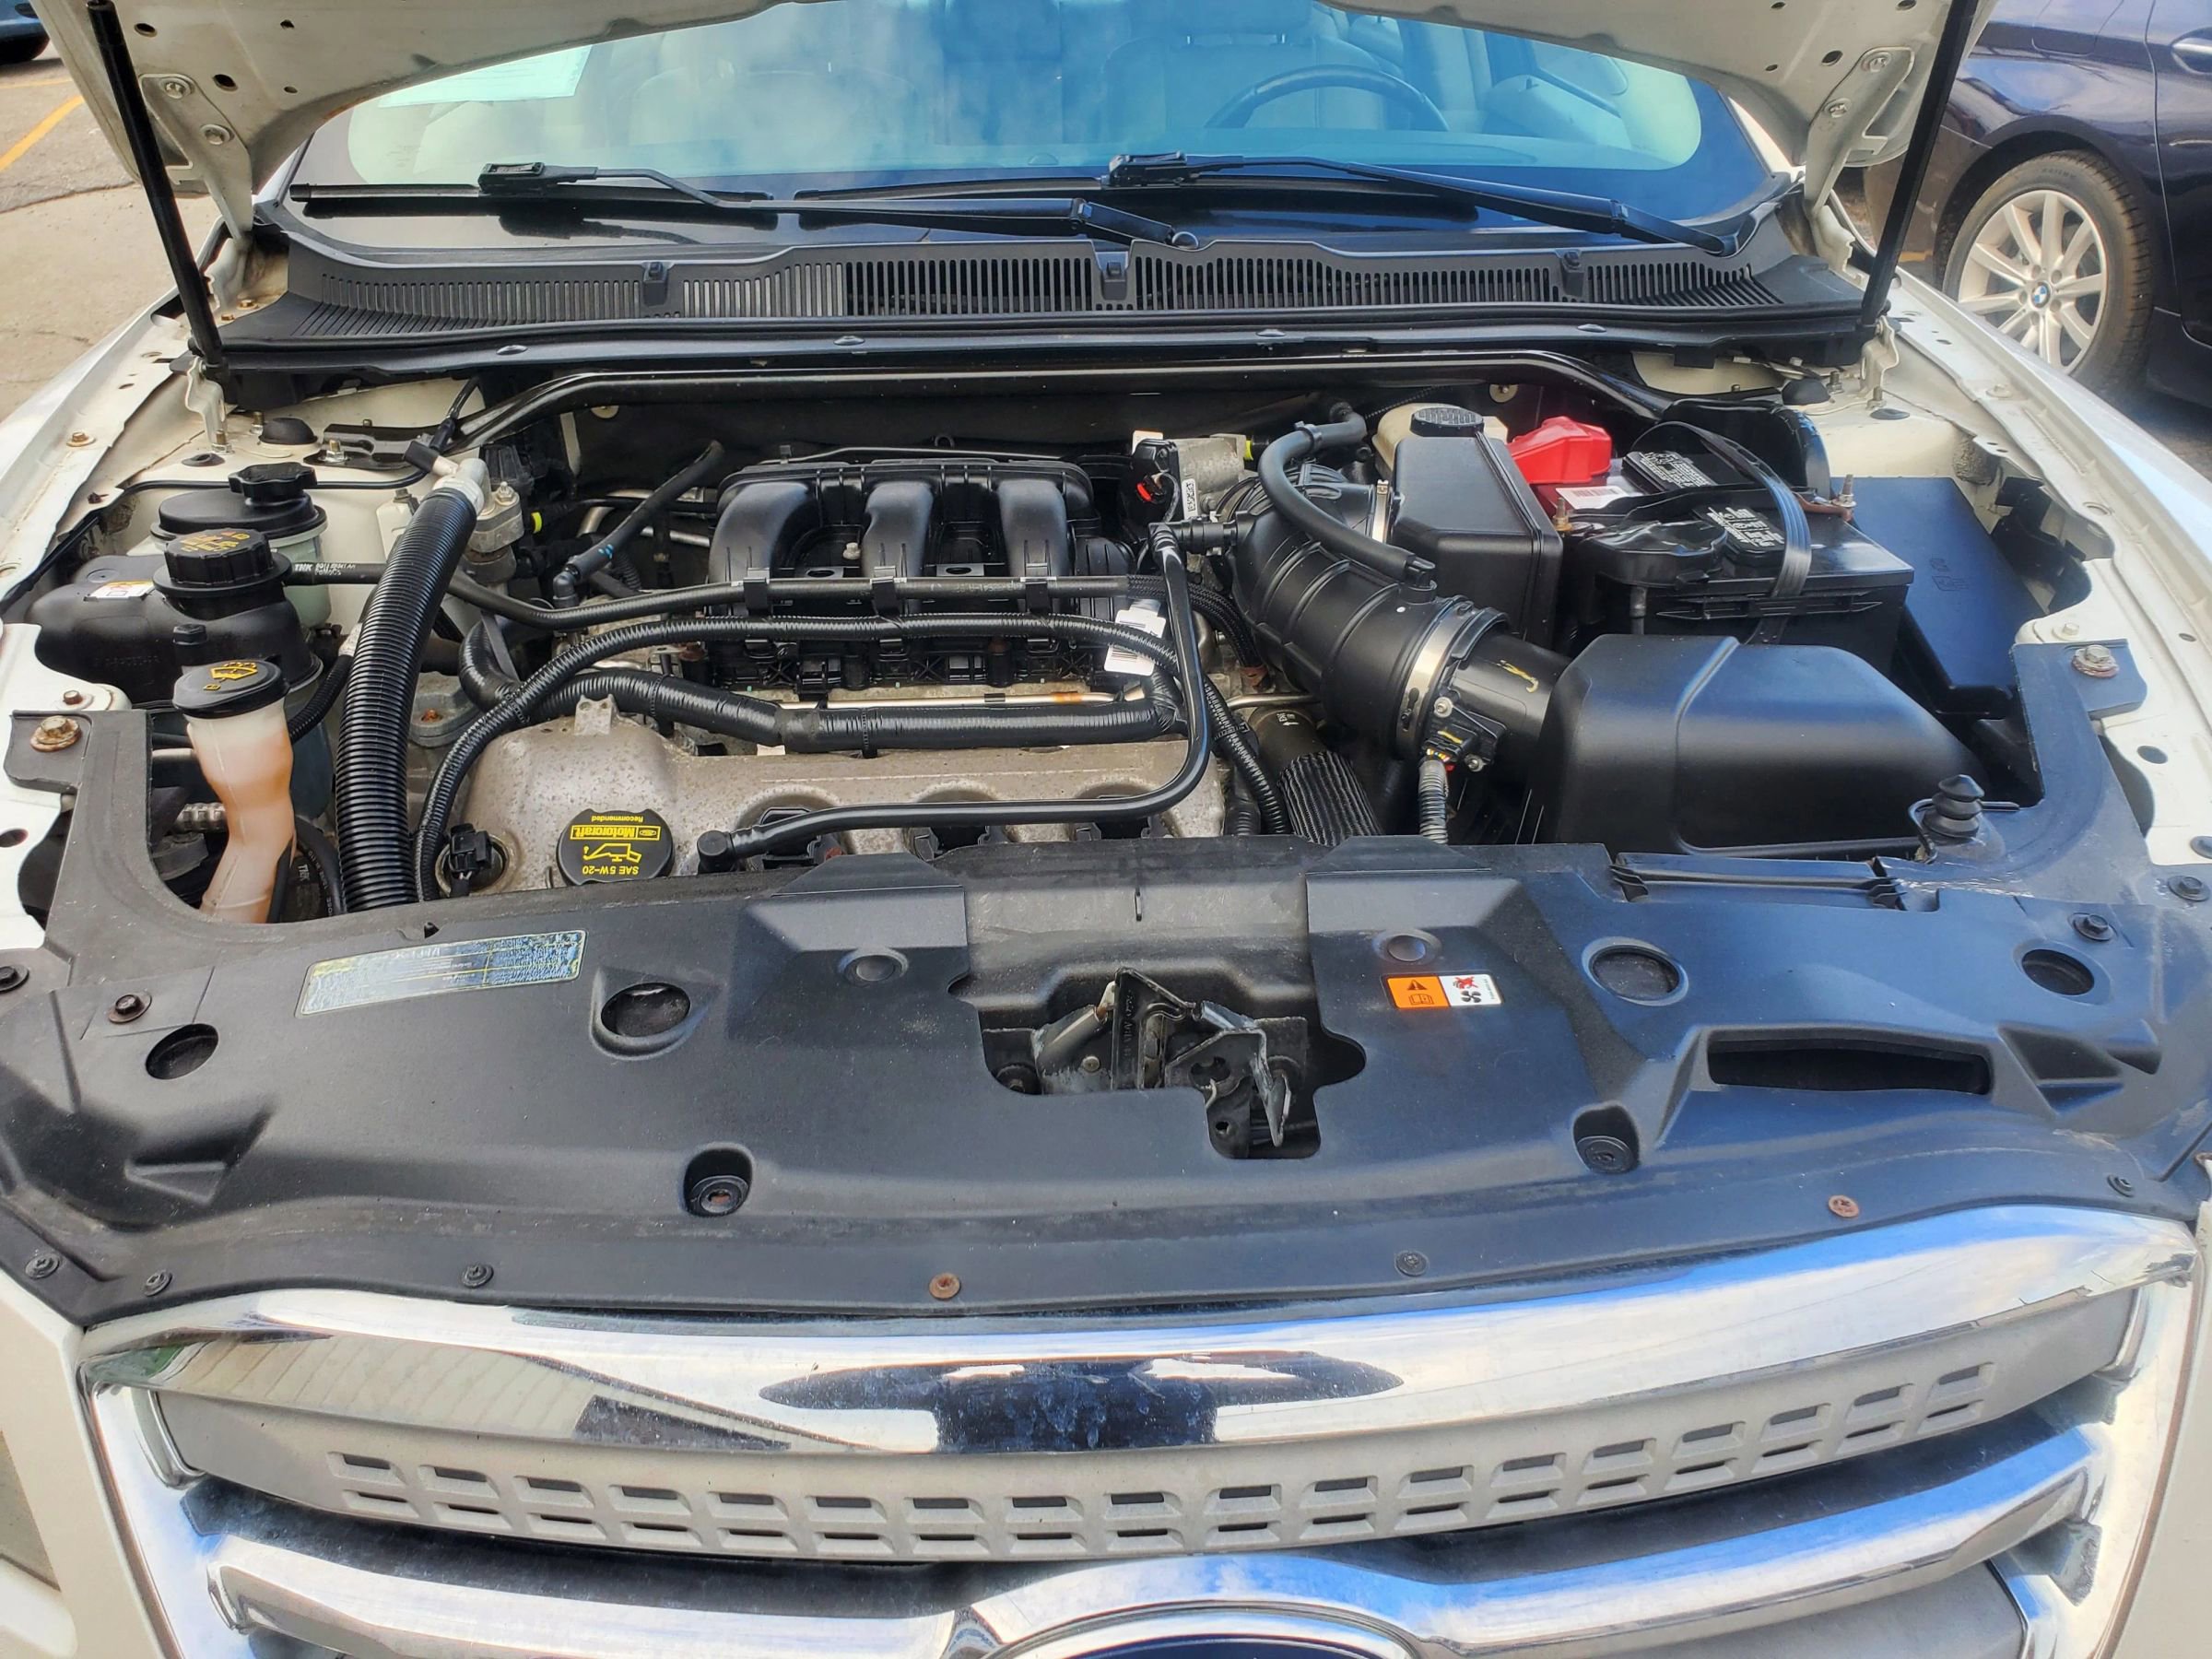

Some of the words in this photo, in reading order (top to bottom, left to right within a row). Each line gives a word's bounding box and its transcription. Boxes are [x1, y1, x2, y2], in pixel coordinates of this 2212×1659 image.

[574, 826, 636, 838] Motorcraft
[582, 865, 617, 875] 5W-20
[618, 865, 640, 875] SAE
